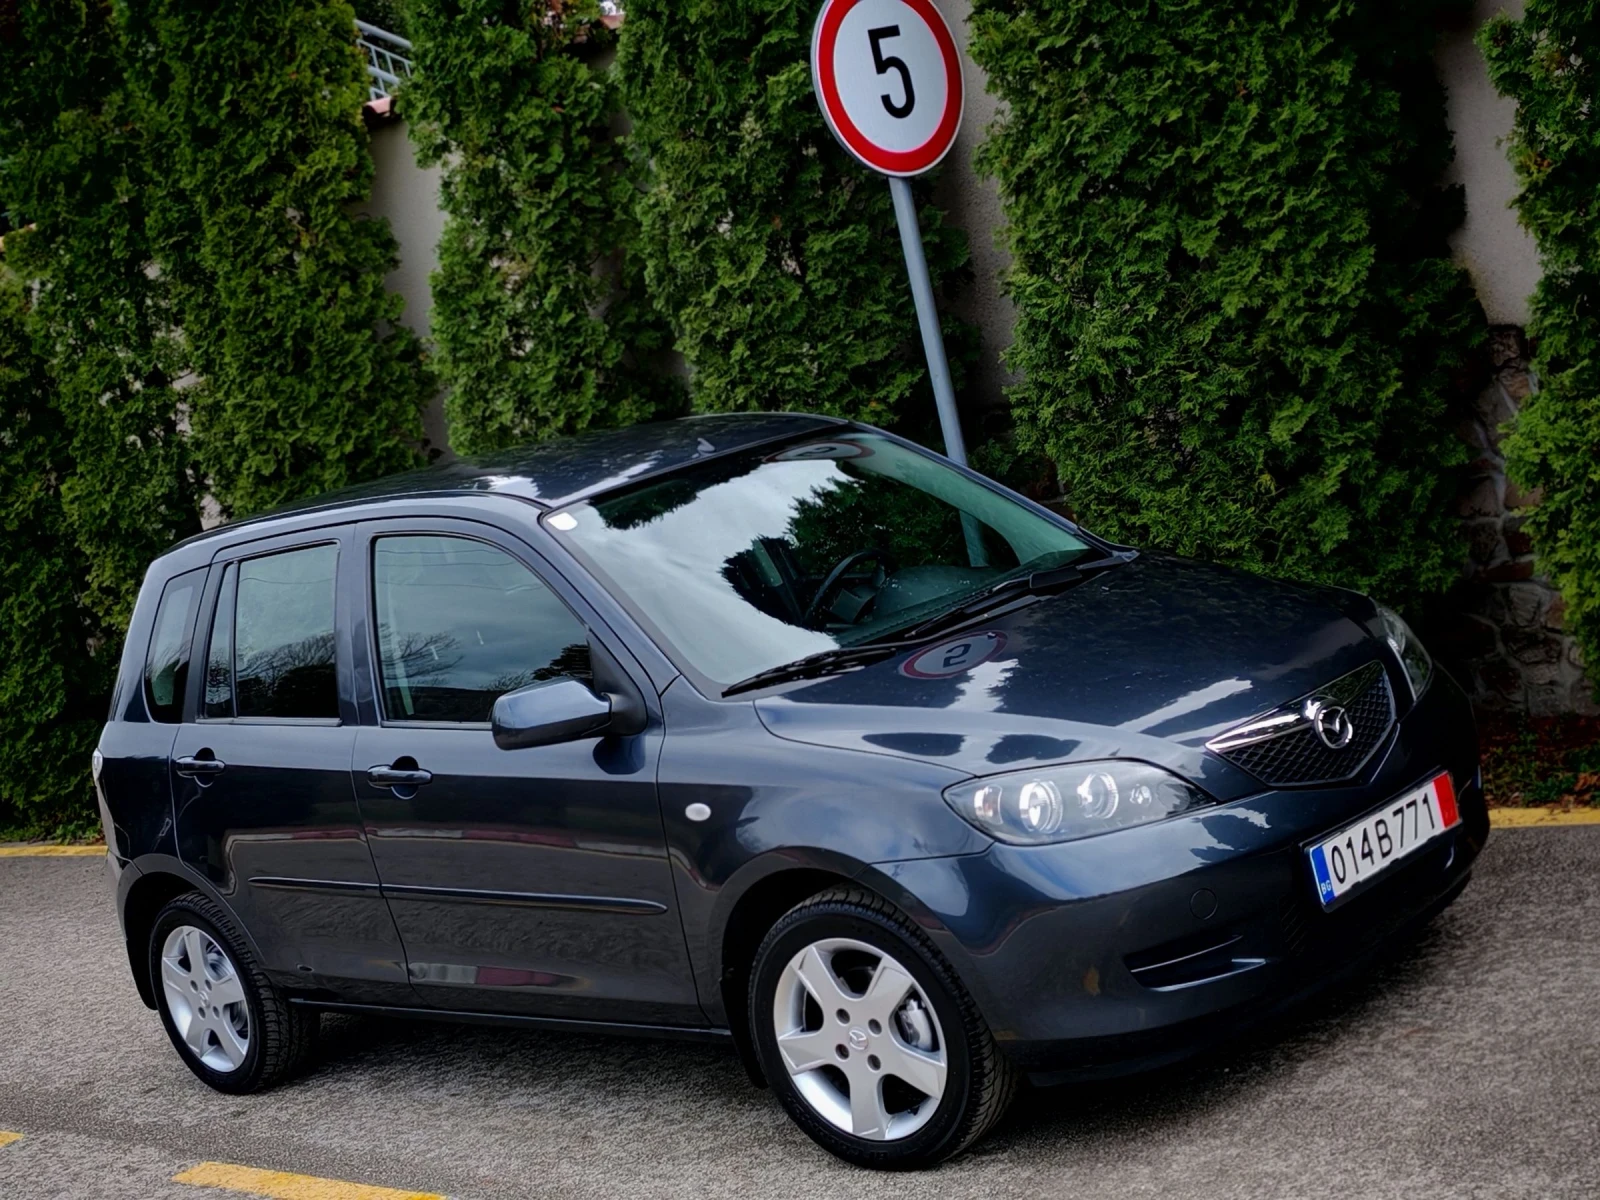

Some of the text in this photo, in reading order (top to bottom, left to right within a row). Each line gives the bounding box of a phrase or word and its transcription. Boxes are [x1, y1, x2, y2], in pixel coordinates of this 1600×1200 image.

[867, 24, 916, 119] 5
[1331, 792, 1436, 885] 014B771
[1320, 879, 1332, 895] BG
